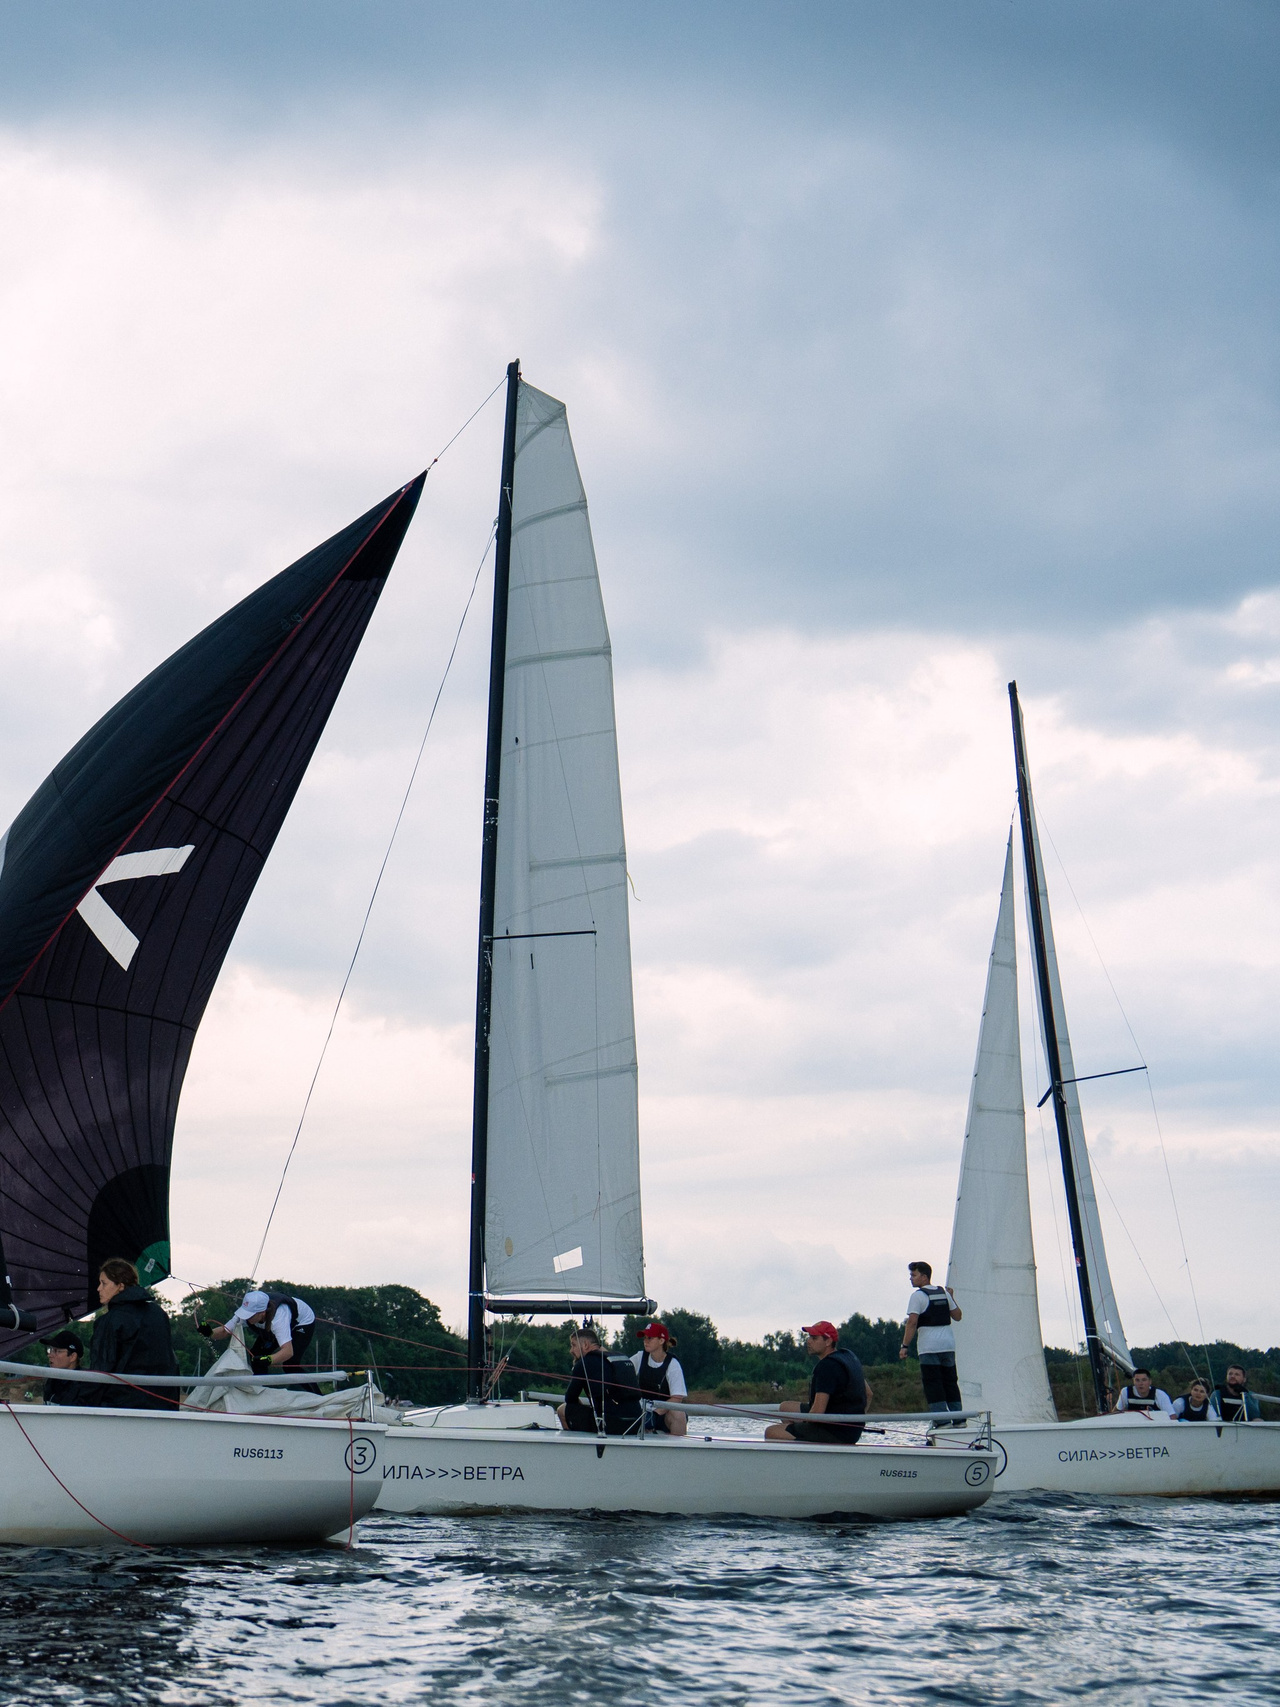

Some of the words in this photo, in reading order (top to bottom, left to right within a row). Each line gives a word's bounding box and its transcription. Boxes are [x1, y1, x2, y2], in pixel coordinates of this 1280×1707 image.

[232, 1447, 284, 1460] RUS6113
[354, 1446, 368, 1466] 3
[382, 1464, 525, 1482] ИЛА>>>ВЕТРА
[879, 1469, 918, 1479] RUS6115
[971, 1467, 983, 1481] 5
